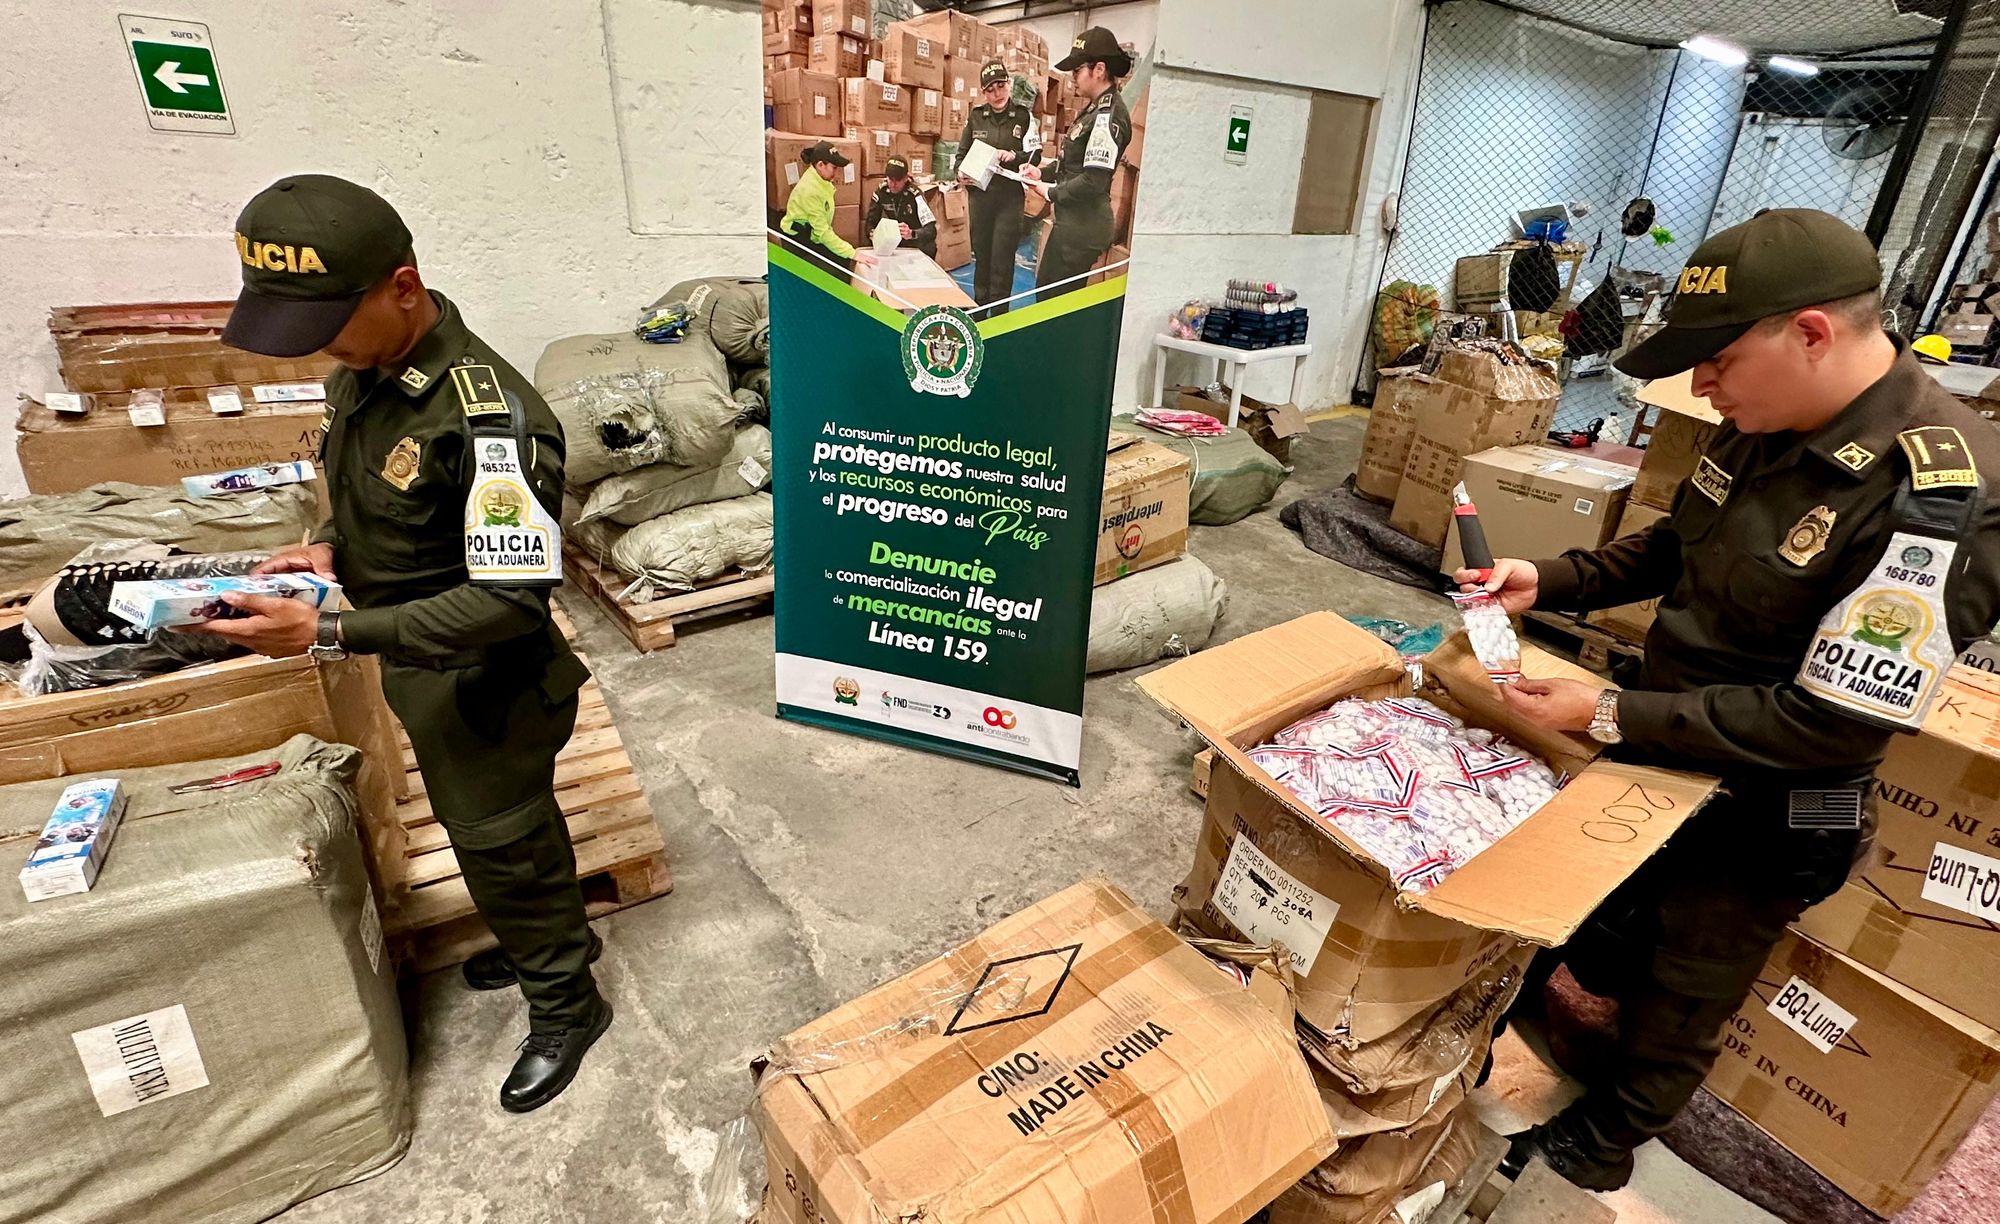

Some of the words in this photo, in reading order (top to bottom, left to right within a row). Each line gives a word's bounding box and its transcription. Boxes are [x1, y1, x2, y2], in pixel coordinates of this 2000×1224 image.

[812, 441, 964, 480] protegemos
[966, 466, 1014, 485] nuestra
[1020, 472, 1066, 494] salud
[822, 422, 835, 435] Al
[838, 426, 895, 444] consumir
[898, 434, 914, 447] un
[918, 432, 1000, 458] producto
[1006, 440, 1058, 471] legal,
[808, 470, 818, 484] y
[819, 467, 837, 484] los
[840, 469, 914, 494] recursos
[919, 481, 1032, 514] económicos
[1036, 502, 1068, 520] para
[1102, 500, 1163, 534] interplast
[466, 534, 544, 552] POLICIA
[822, 492, 833, 506] el
[837, 492, 948, 526] progreso
[954, 513, 974, 529] del
[978, 509, 1050, 550] País
[468, 554, 488, 566] FISCAL
[490, 554, 495, 566] Y
[498, 554, 546, 566] ADUANERA
[869, 541, 997, 585] Denuncie
[1885, 566, 1936, 587] 168780
[824, 570, 833, 580] la
[836, 569, 960, 602] comercialización
[965, 586, 1042, 622] ilegal
[832, 594, 844, 605] de
[847, 593, 992, 636] mercancías
[996, 626, 1016, 638] ante
[1018, 628, 1026, 640] la
[868, 620, 934, 654] Línea
[1806, 661, 1835, 683] FISCAL
[1836, 672, 1848, 686] Y
[1846, 676, 1914, 709] ADUANERA
[1812, 638, 1922, 692] POLICIA
[893, 696, 908, 708] FND
[966, 722, 1030, 744] anticontrabando
[1871, 777, 1939, 818] CHIN
[1945, 812, 1983, 837] IN
[1238, 841, 1264, 870] ORDER
[1264, 865, 1277, 880] NO
[1277, 876, 1314, 906] 0011252
[1271, 906, 1291, 925] PCS
[1290, 952, 1306, 968] CM
[1776, 984, 1846, 1046] BQ-Luna
[976, 1048, 1048, 1100] C/NO:
[1006, 1074, 1085, 1138] MADE
[1082, 1062, 1104, 1090] IN
[1100, 1020, 1174, 1082] CHINA
[1724, 1033, 1749, 1059] DE
[1754, 1054, 1780, 1078] IN
[1784, 1075, 1848, 1128] CHINA
